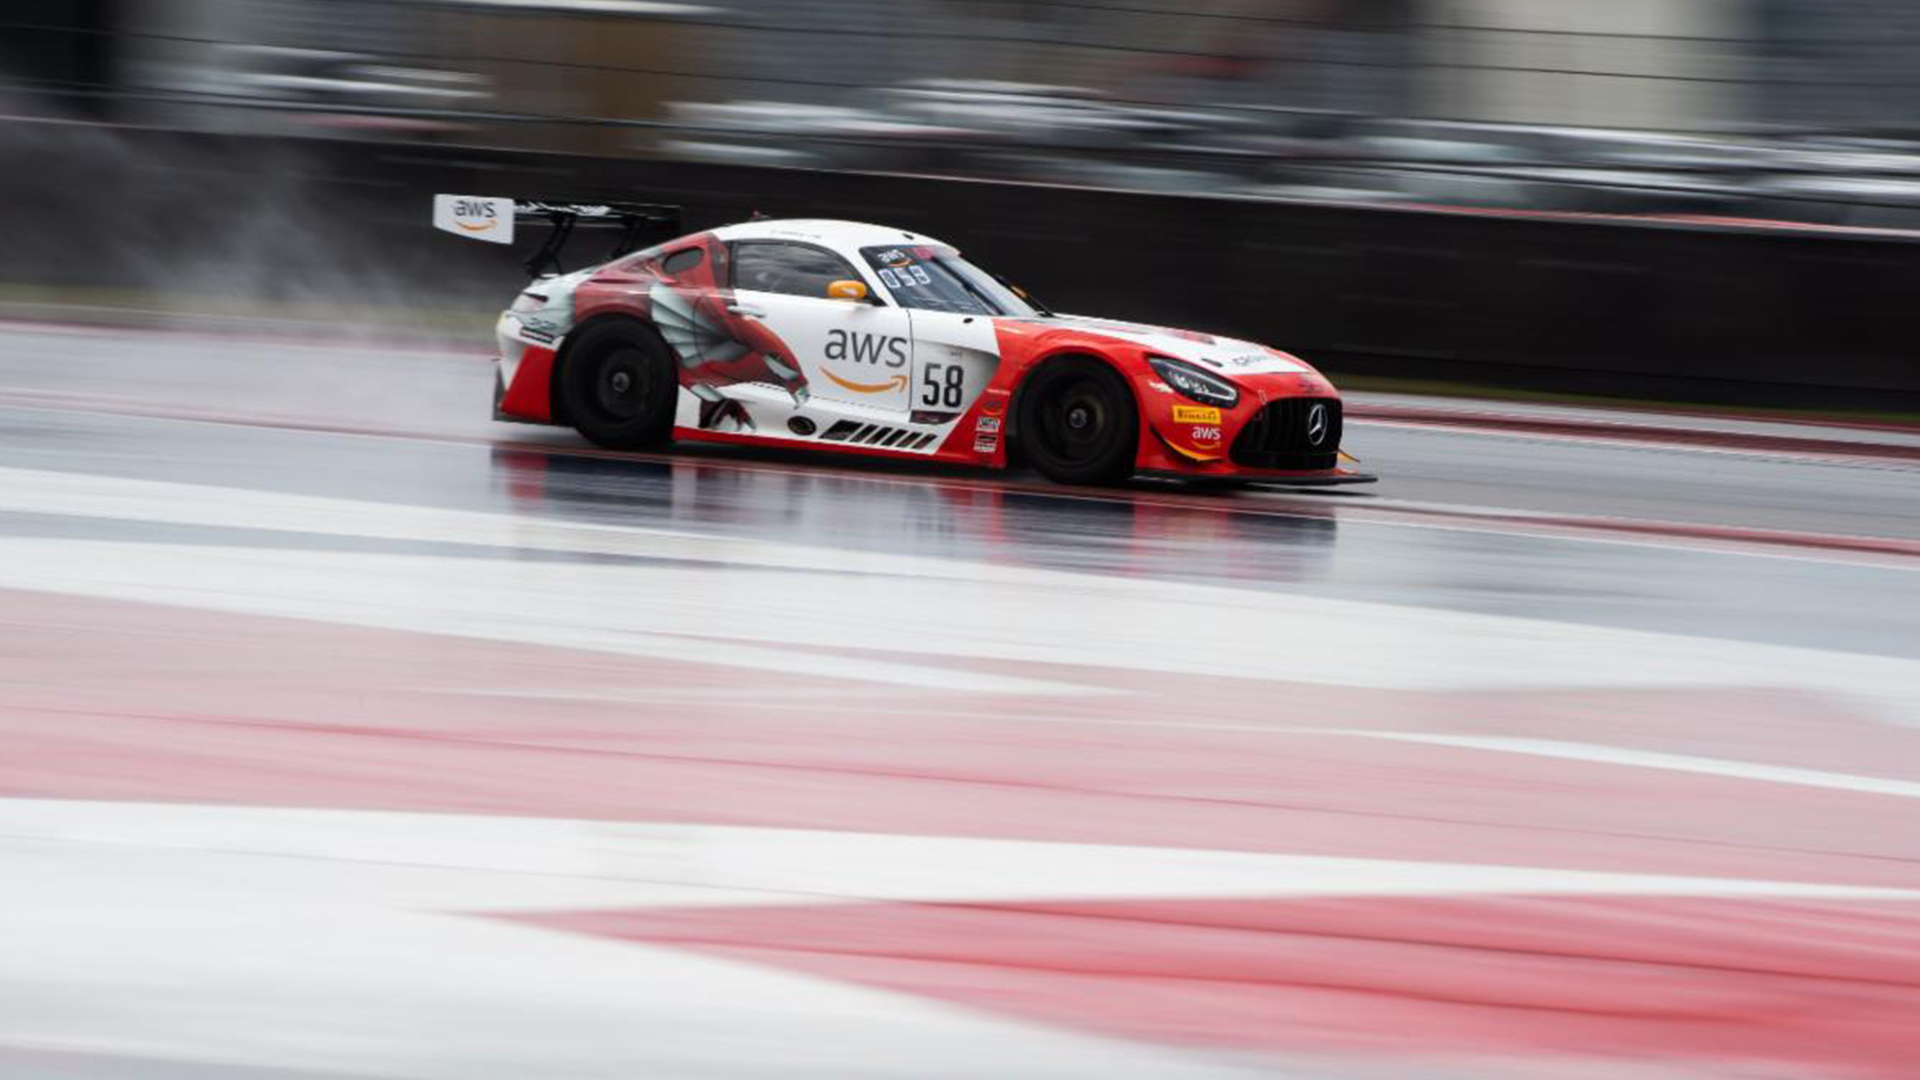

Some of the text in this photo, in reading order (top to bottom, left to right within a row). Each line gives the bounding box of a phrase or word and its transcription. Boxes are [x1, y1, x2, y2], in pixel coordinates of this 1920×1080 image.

[455, 200, 497, 218] aws
[824, 328, 908, 368] aws
[922, 362, 964, 408] 58
[1192, 426, 1221, 440] aws
